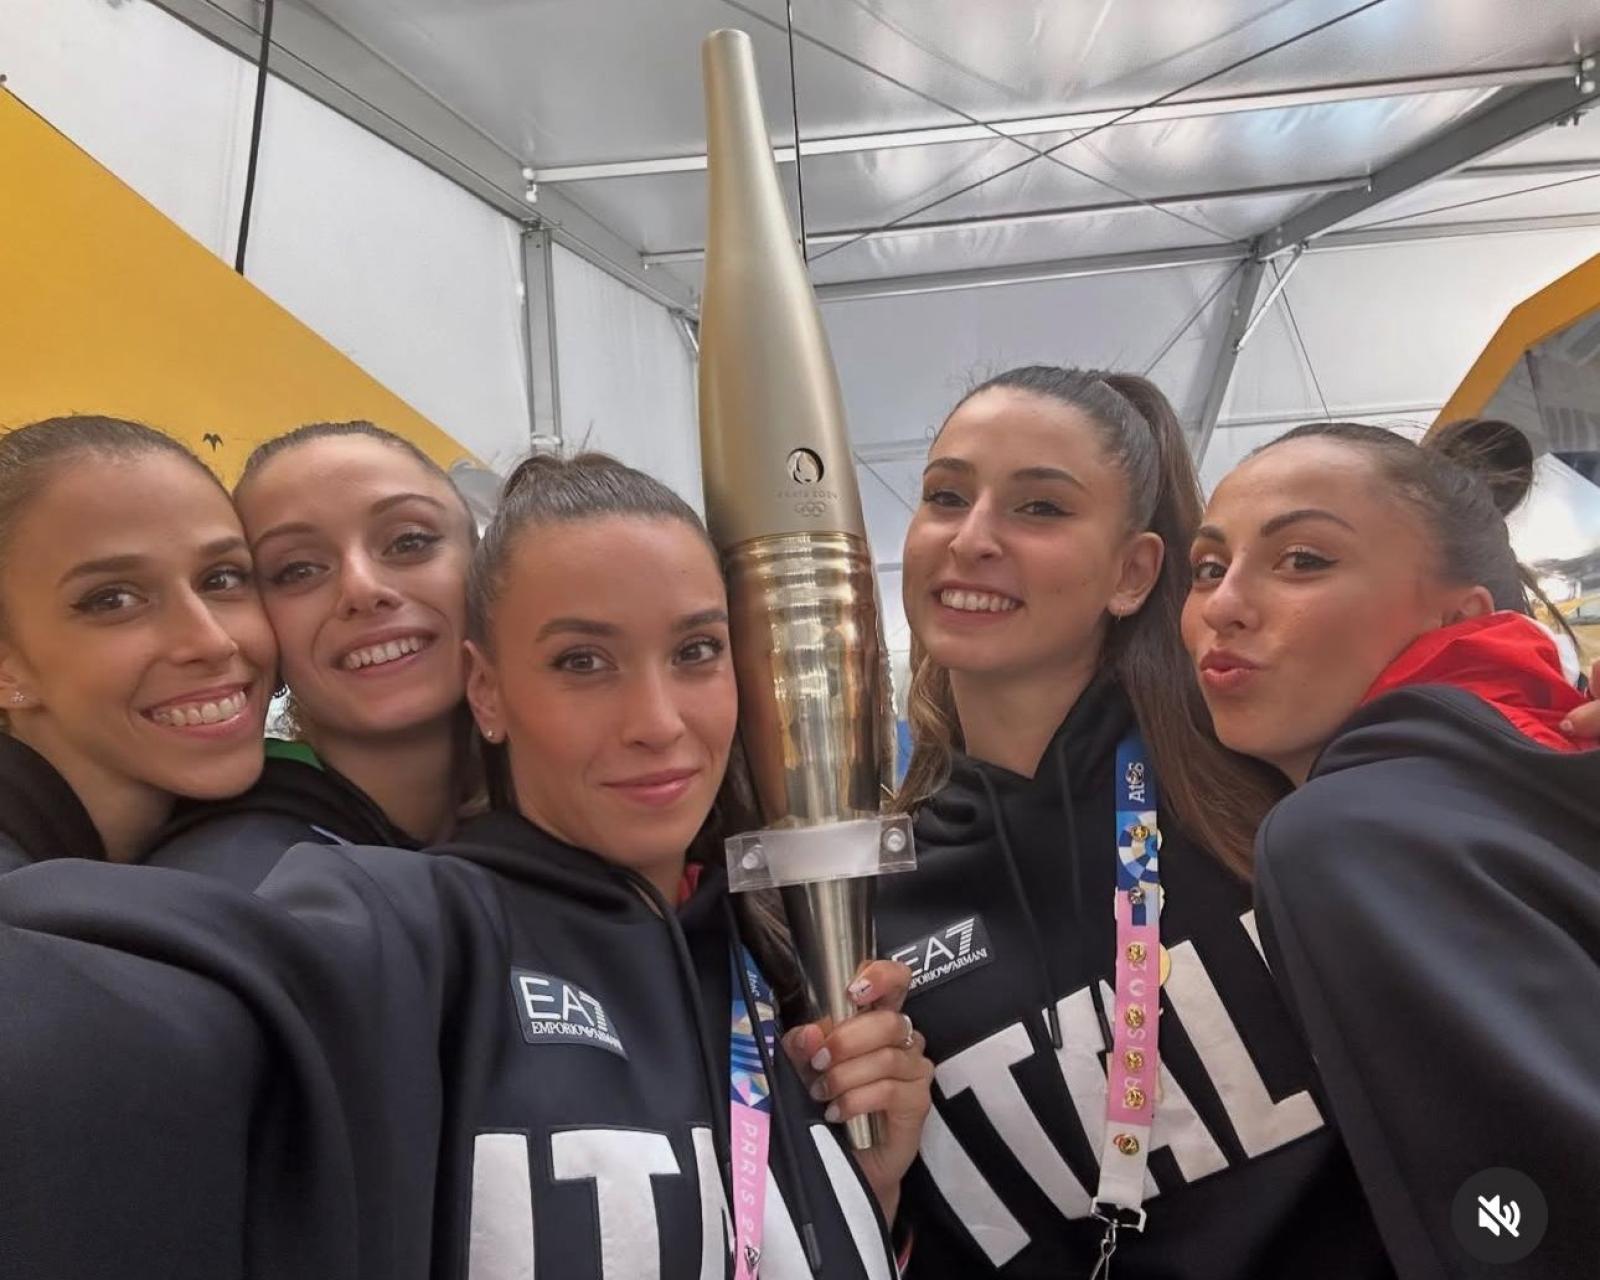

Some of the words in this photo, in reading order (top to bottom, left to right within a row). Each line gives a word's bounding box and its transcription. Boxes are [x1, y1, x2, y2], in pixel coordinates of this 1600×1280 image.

[1128, 762, 1146, 804] Ats
[519, 976, 609, 1033] EA7
[531, 1021, 584, 1036] EMPORIO
[740, 1120, 758, 1207] PARIS
